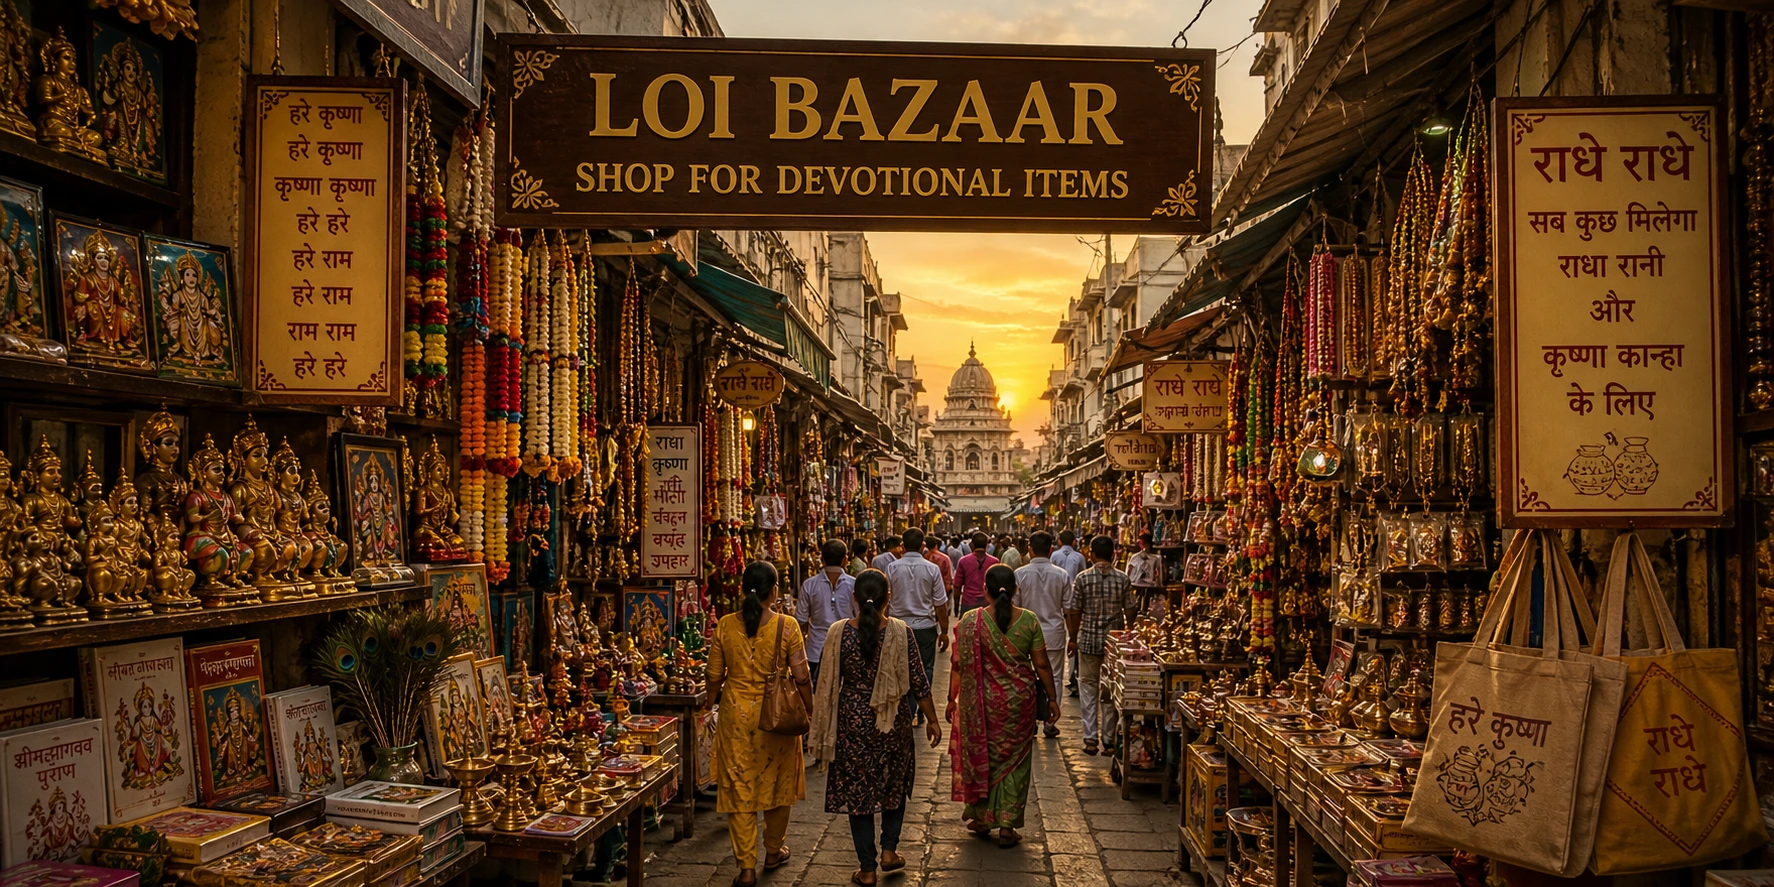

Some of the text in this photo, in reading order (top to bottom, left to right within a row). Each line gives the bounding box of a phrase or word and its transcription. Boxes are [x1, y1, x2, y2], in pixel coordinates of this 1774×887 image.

[289, 98, 312, 125] हरे
[589, 73, 1123, 144] LOI BAZAAR
[287, 134, 310, 161] हरे
[1531, 131, 1695, 182] राधे राधे
[274, 177, 323, 201] कृष्णा
[576, 163, 1128, 198] SHOP FOR DEVOTIONAL ITEMS
[296, 207, 350, 235] हरे हरे
[1528, 201, 1698, 241] सब कुछ मिलेगा
[292, 243, 353, 271] हरे राम
[1558, 246, 1665, 278] राधा रानी
[291, 279, 353, 307] हरे राम
[1590, 290, 1635, 322] और
[287, 323, 357, 341] राम राम
[293, 351, 347, 380] हरे हरे
[1542, 345, 1685, 377] कृष्णा कान्हा
[1567, 382, 1656, 420] के लिए
[1449, 697, 1485, 735] हरे
[1643, 714, 1694, 755] राधे
[1650, 756, 1706, 799] राधे
